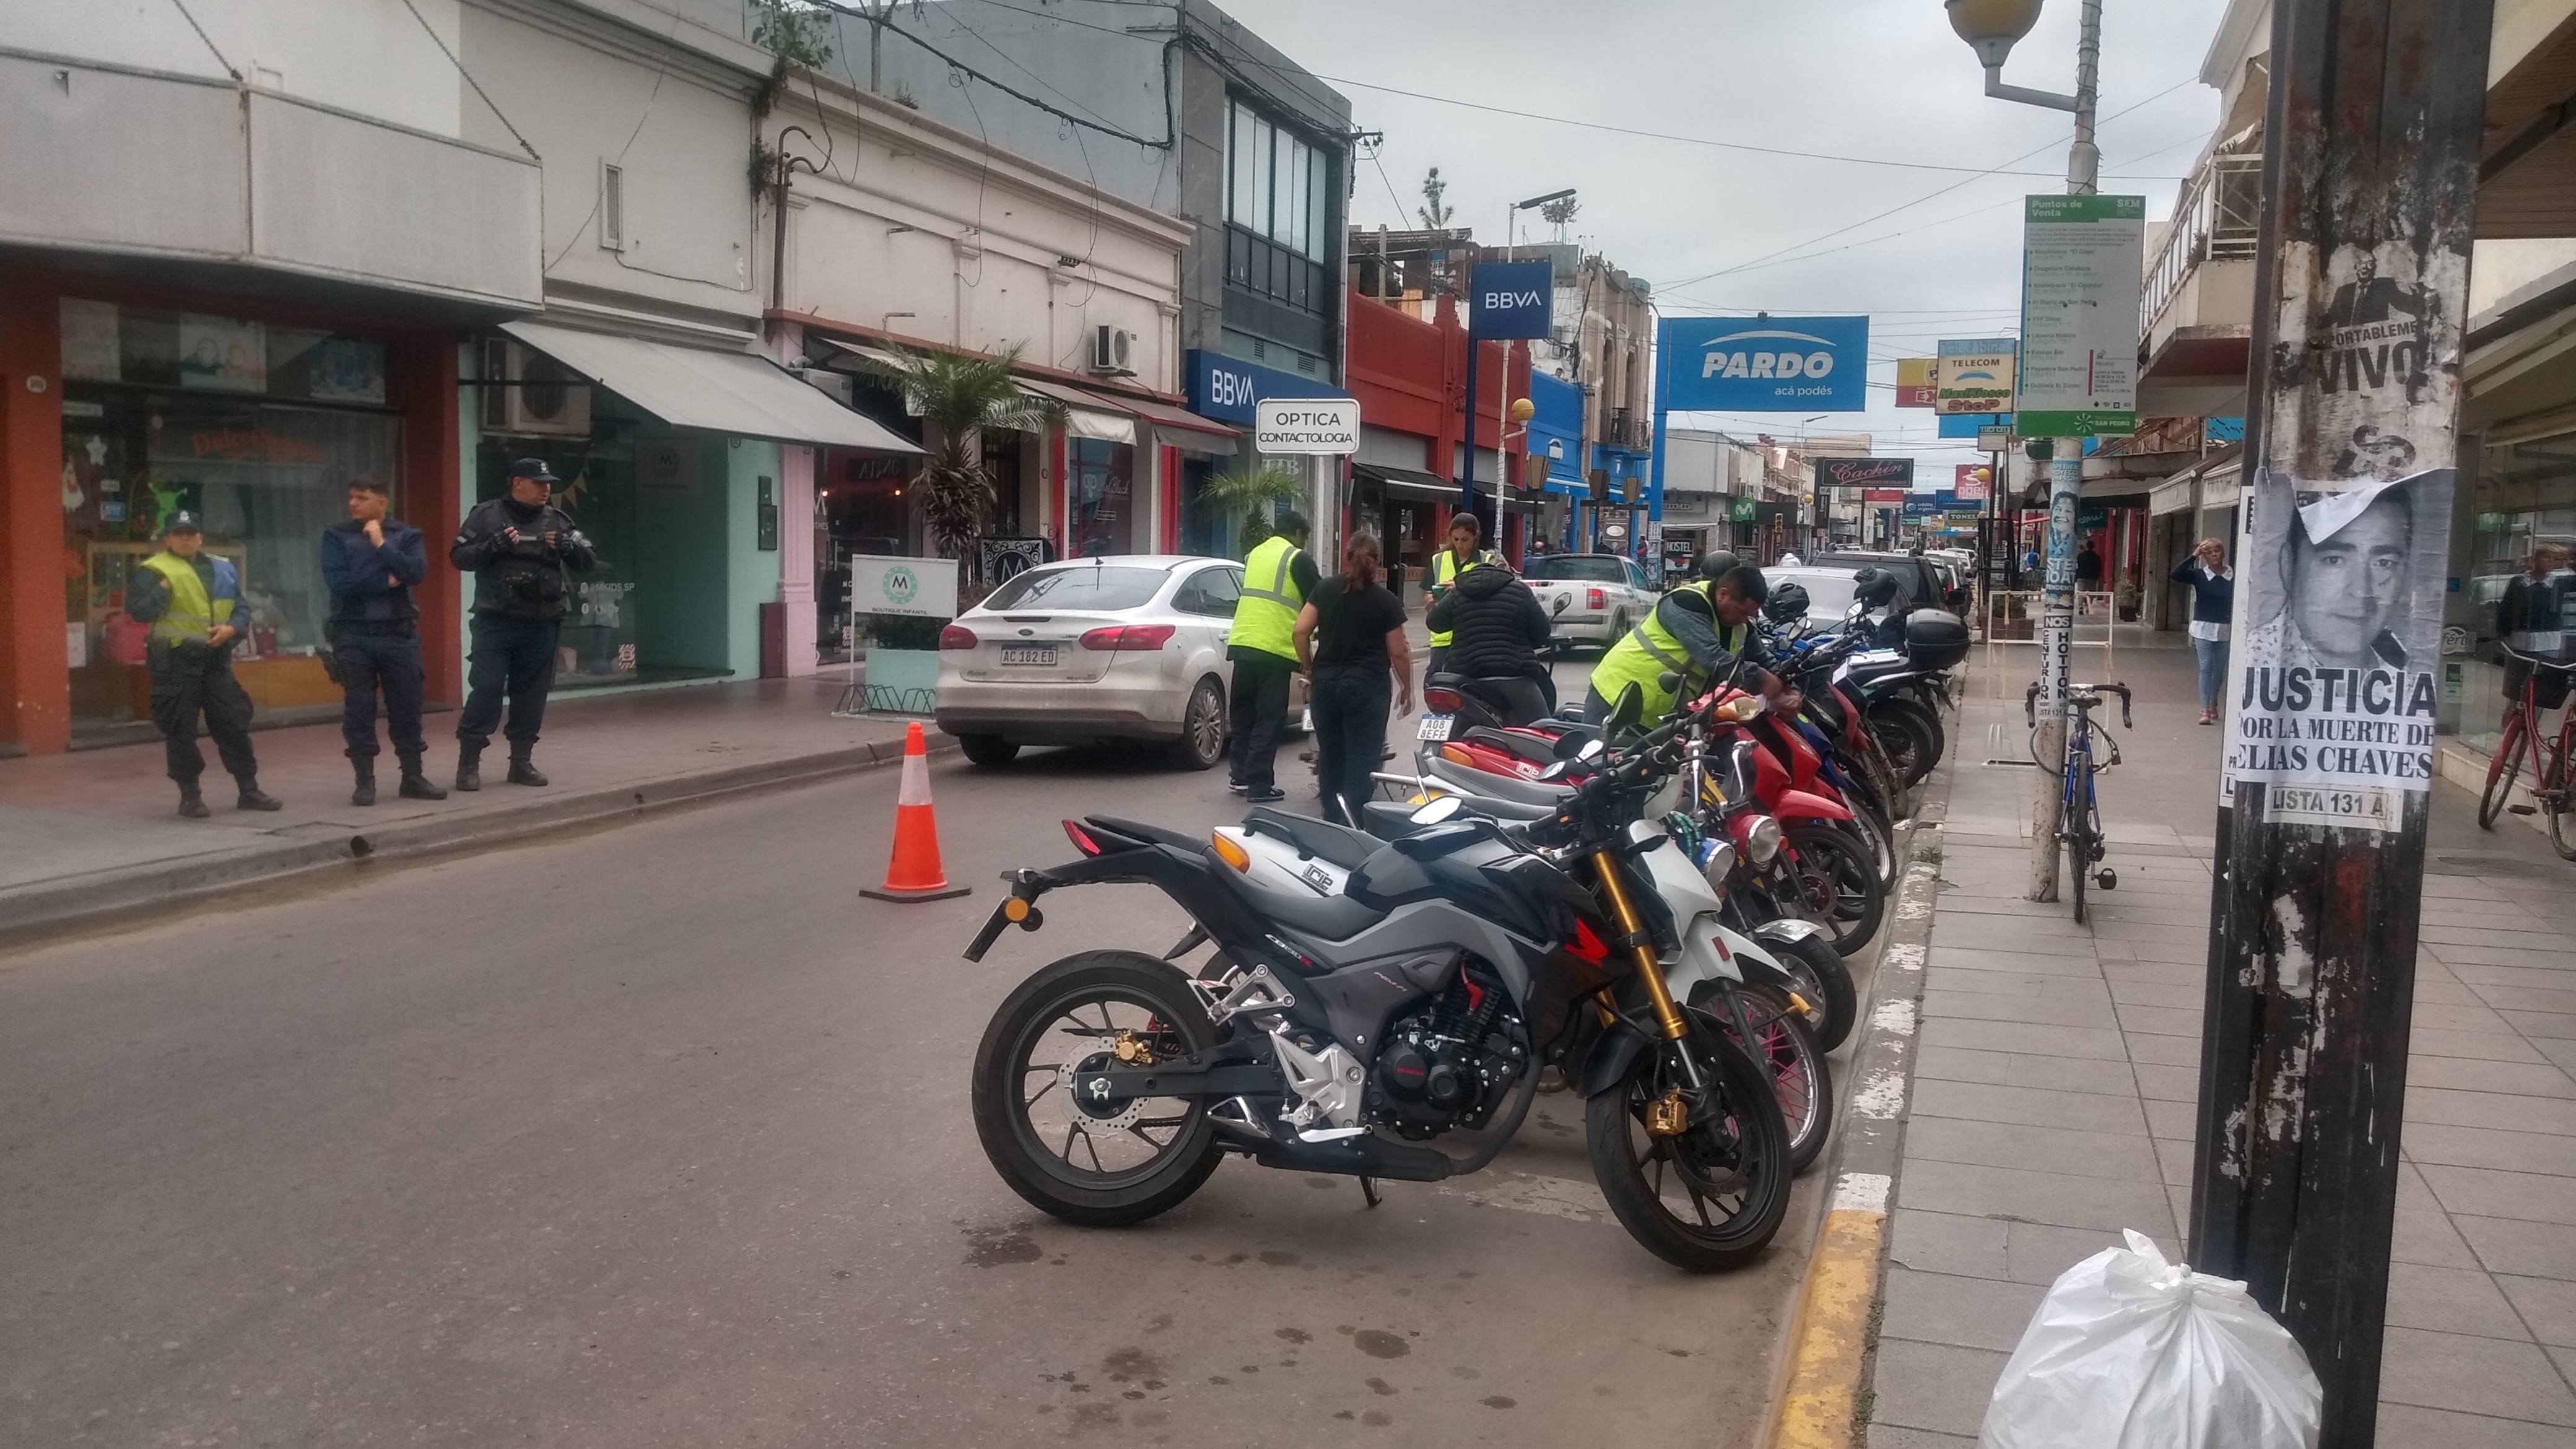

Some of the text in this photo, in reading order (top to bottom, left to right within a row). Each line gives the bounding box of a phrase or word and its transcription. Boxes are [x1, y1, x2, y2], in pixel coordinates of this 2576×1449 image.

[2117, 199, 2140, 207] SEM
[1486, 289, 1542, 309] BBVA
[1702, 352, 1834, 378] PARDO
[1212, 368, 1255, 407] BBVA
[1775, 386, 1832, 397] acá podés
[1276, 413, 1341, 426] OPTICA
[1259, 433, 1354, 443] CONTACTOLOGIA
[1666, 541, 1692, 552] HOSTEL
[892, 576, 908, 589] M
[1003, 651, 1054, 662] AC 182 ED
[2040, 629, 2050, 700] CENTURION
[2056, 632, 2069, 699] HOTTON
[2242, 666, 2437, 718] JUSTICIA
[1425, 720, 1445, 729] A08
[2278, 718, 2301, 739] LA
[2307, 718, 2400, 744] MUERTE
[1420, 729, 1447, 739] 8EFF
[2317, 746, 2434, 780] CHAVES
[2273, 790, 2384, 817] LISTA 131 A
